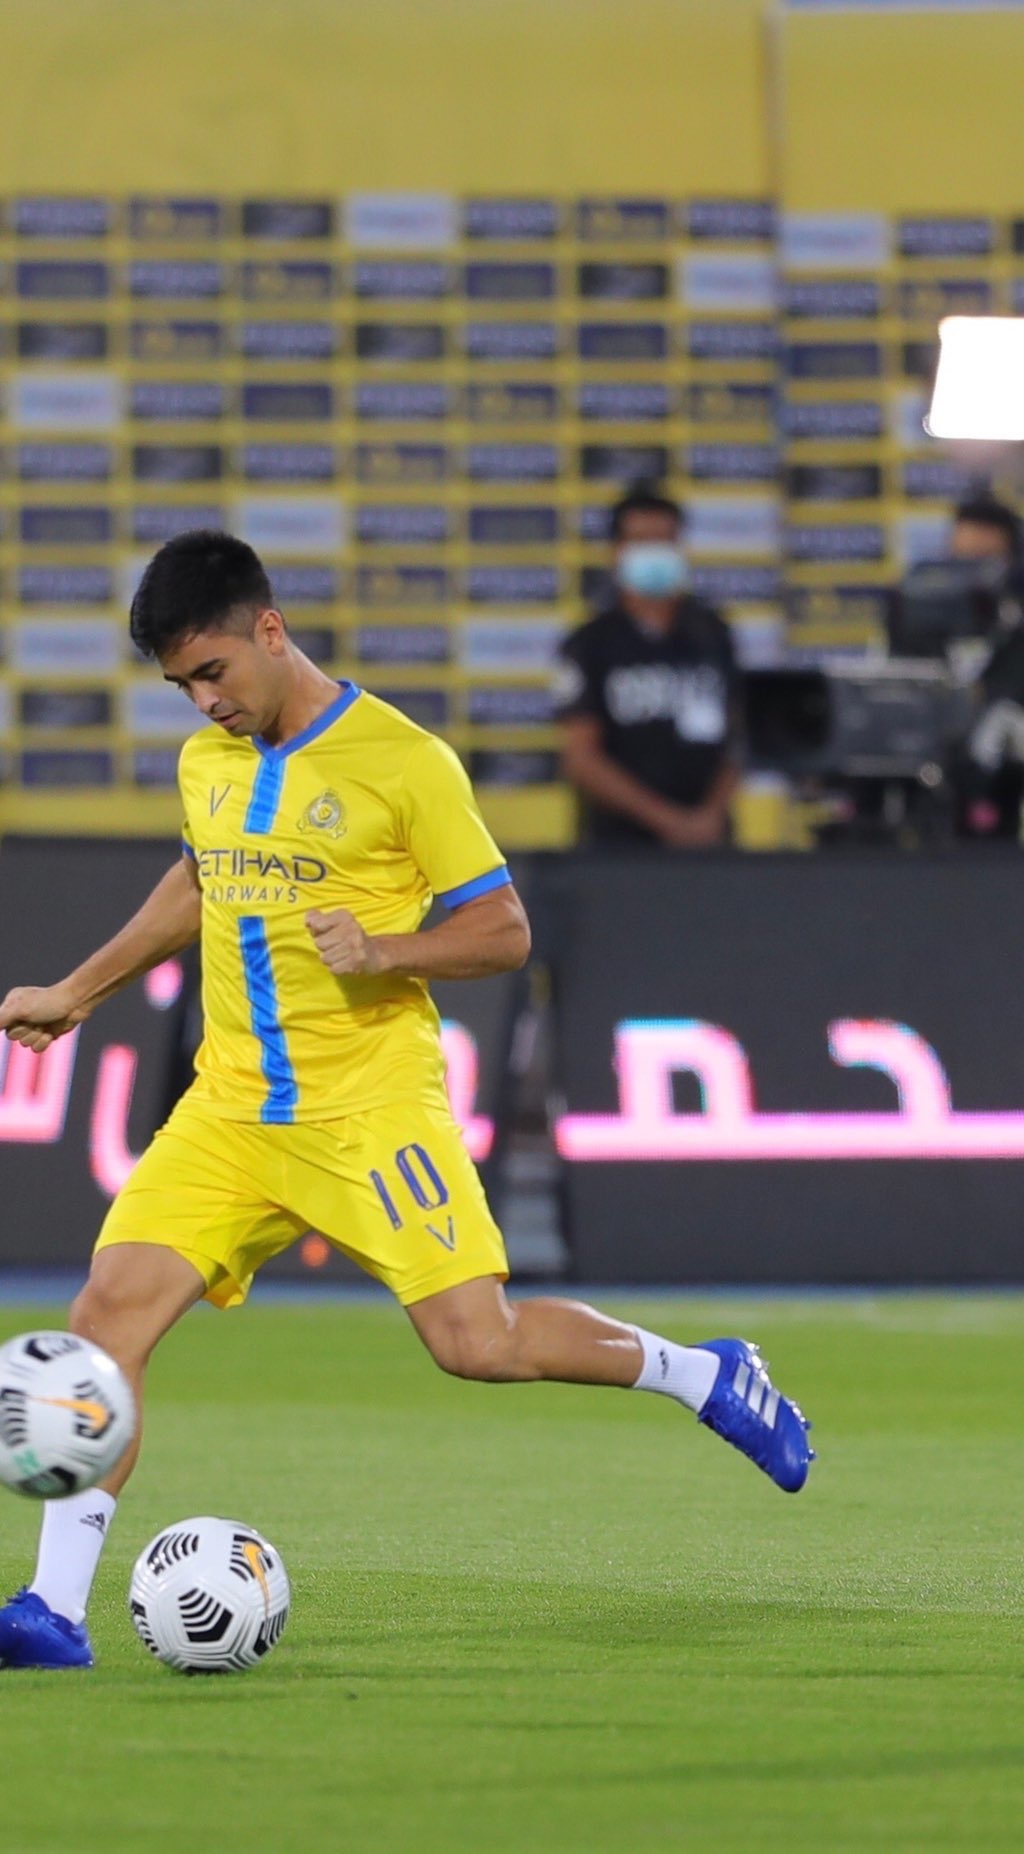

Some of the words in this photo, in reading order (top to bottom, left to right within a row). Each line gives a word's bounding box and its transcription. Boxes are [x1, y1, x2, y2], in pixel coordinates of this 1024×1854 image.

[199, 848, 326, 883] ETIHAD
[209, 885, 298, 903] AIRWAYS
[369, 1143, 449, 1231] 10
